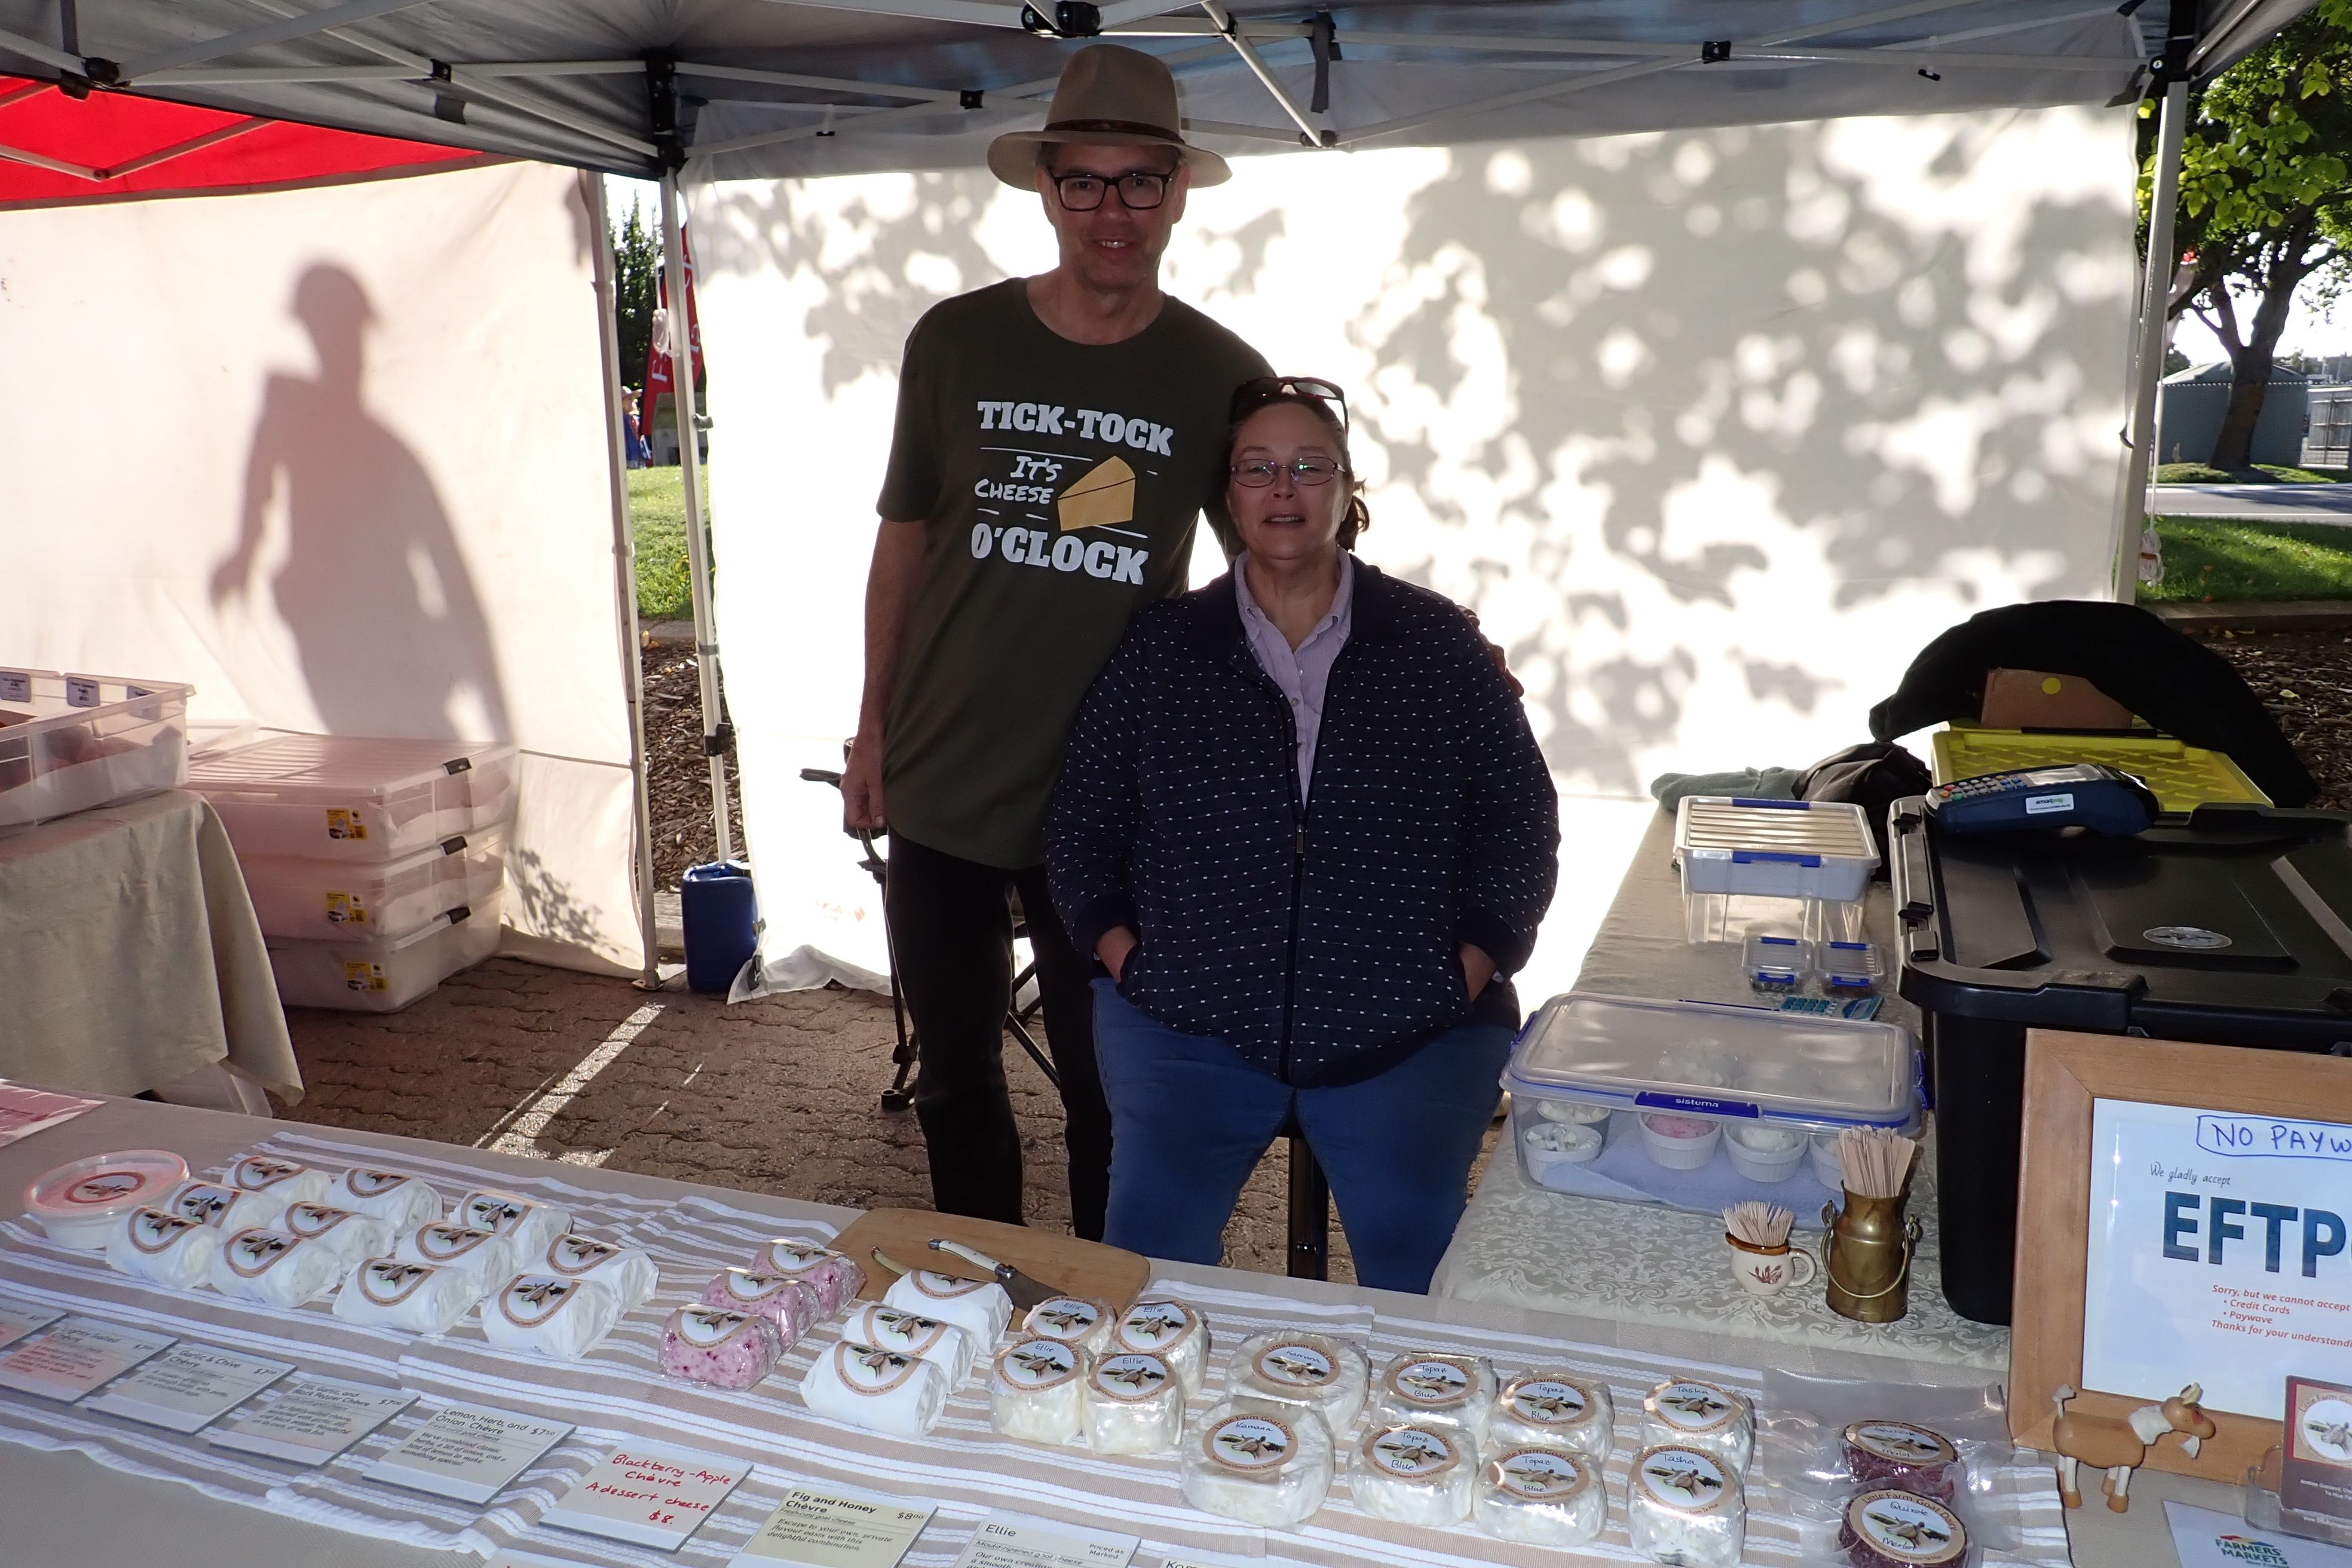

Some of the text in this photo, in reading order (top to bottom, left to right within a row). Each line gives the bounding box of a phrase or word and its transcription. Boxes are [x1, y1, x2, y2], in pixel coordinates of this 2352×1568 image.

[977, 401, 1174, 457] TICK-TOCK
[1010, 456, 1062, 482] IT'S
[975, 479, 1054, 504] CHEESE
[971, 523, 1149, 585] O'CLOCK
[2212, 1123, 2352, 1153] NO PAYW
[2151, 1162, 2231, 1189] We gladly accept
[2163, 1190, 2352, 1278] EFTP
[2212, 1285, 2240, 1297] Sorry,
[2243, 1290, 2260, 1298] but
[2280, 1296, 2314, 1306] cannot
[2317, 1300, 2350, 1312] accept
[2230, 1299, 2290, 1315] Credit Cards
[2230, 1311, 2273, 1324] Paywave
[2212, 1319, 2246, 1331] Thanks
[2248, 1325, 2264, 1334] for
[2265, 1329, 2289, 1338] your
[1036, 1343, 1054, 1352] Ellie
[1266, 1344, 1285, 1352] Little
[215, 1358, 241, 1368] Chive
[1287, 1350, 1322, 1364] Kamana
[1418, 1365, 1447, 1374] Topaz
[1414, 1390, 1436, 1399] Blue
[1535, 1383, 1564, 1394] Topaz
[1670, 1386, 1710, 1395] Tasha
[443, 1408, 529, 1431] Lemon, Herb, and
[1215, 1418, 1234, 1430] Little
[1261, 1416, 1281, 1427] Goat
[1531, 1411, 1550, 1420] Blue
[436, 1415, 504, 1434] Onion Chèvre
[1236, 1422, 1274, 1432] Kamana
[1401, 1432, 1429, 1443] Topaz
[1521, 1456, 1552, 1466] Topaz
[1659, 1453, 1696, 1465] Tasha
[1688, 1448, 1710, 1459] Goat
[1391, 1460, 1414, 1471] Blue
[586, 1482, 710, 1511] A dessert cheese
[791, 1492, 877, 1514] Fig and Honey
[1861, 1494, 1884, 1503] Little
[1886, 1492, 1912, 1501] Farm
[1916, 1499, 1940, 1515] Goat
[786, 1500, 828, 1513] Chèvre
[771, 1525, 803, 1535] flavour
[828, 1533, 846, 1542] with
[777, 1518, 808, 1528] Escape
[819, 1526, 840, 1534] your
[862, 1533, 893, 1542] private
[985, 1523, 1016, 1537] Ellie
[767, 1532, 860, 1551] delightful combination.
[975, 1539, 1033, 1556] Mould-ripened
[1089, 1543, 1114, 1552] Priced
[2215, 1539, 2281, 1555] FARMERS'
[1089, 1549, 1119, 1560] Marked
[2221, 1548, 2288, 1564] MARKETS
